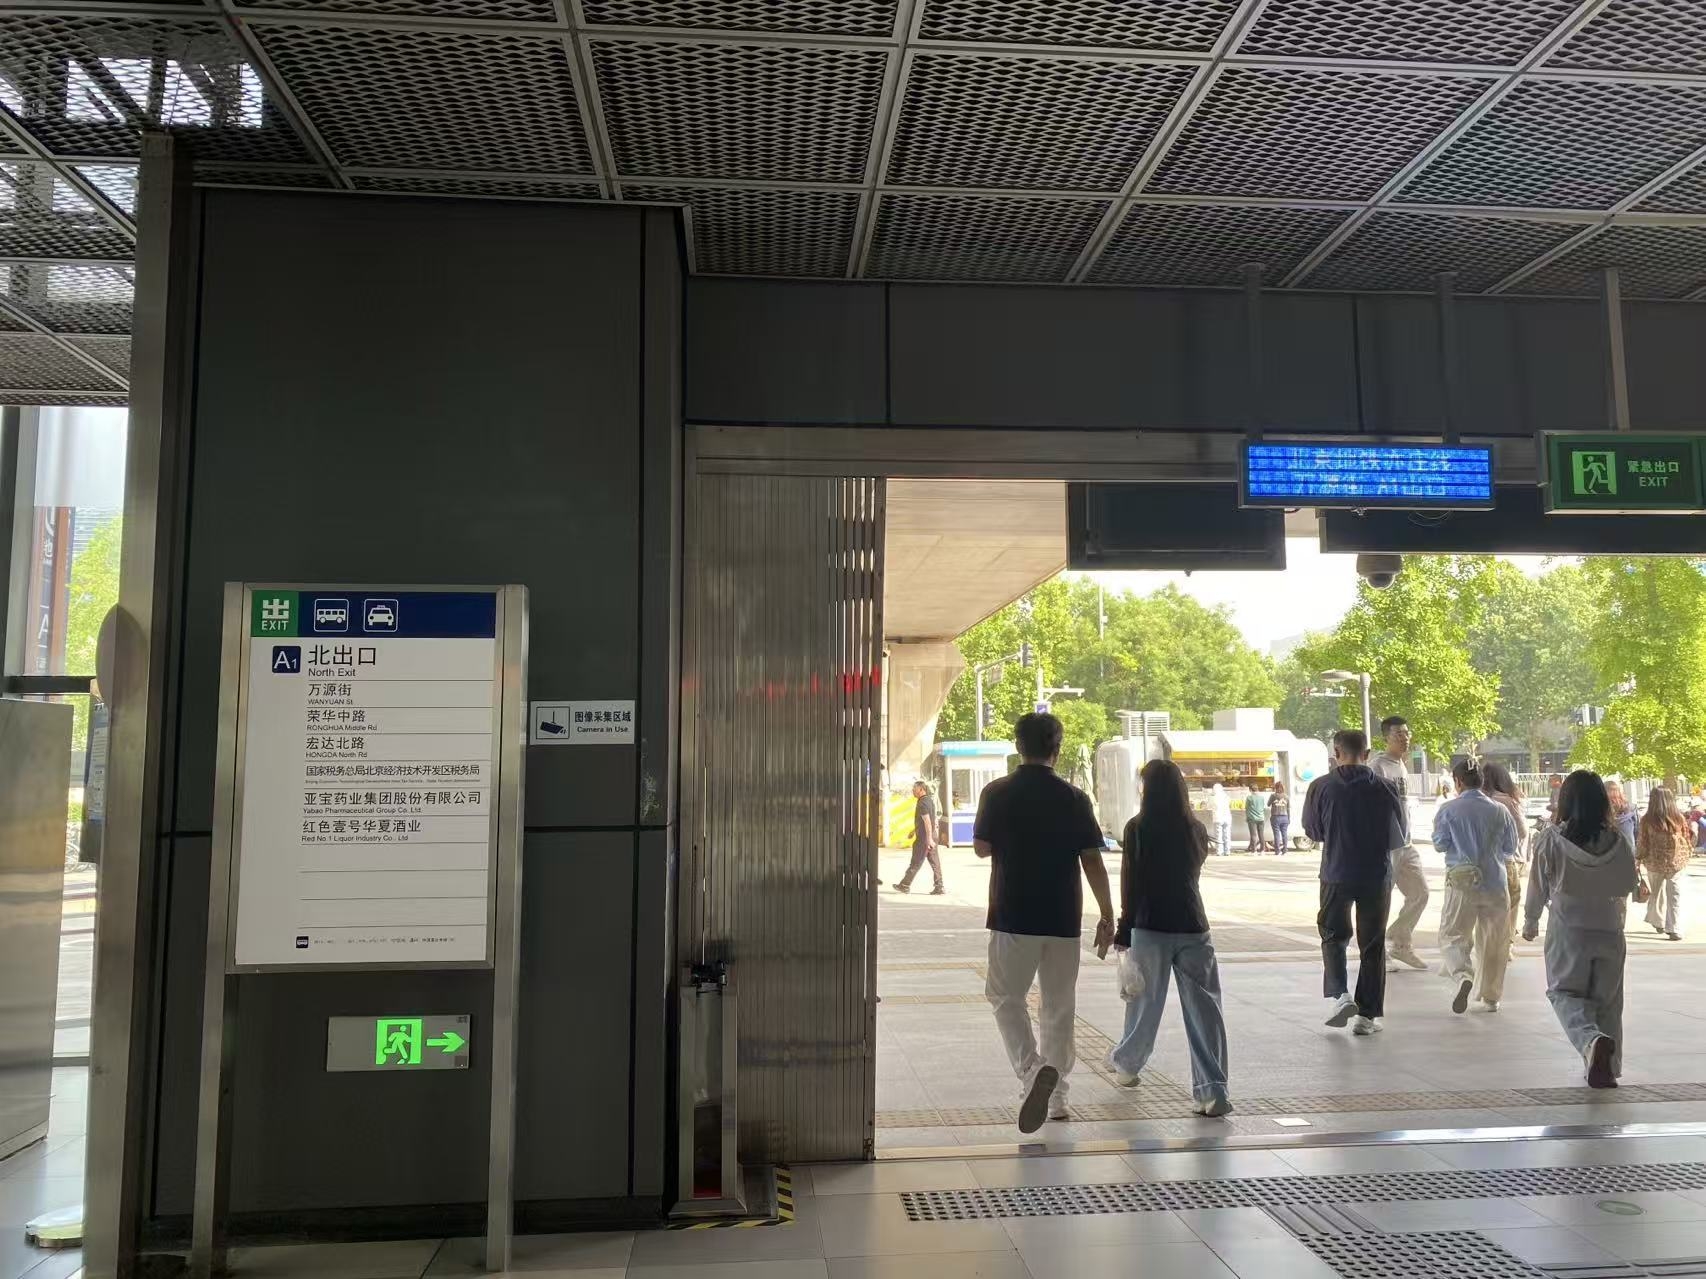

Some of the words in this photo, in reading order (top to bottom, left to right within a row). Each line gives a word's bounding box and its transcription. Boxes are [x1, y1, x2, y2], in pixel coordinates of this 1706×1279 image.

[1627, 460, 1679, 473] 紧急出口
[1639, 476, 1669, 487] EXIT
[262, 598, 290, 620] 出
[261, 620, 289, 631] EXIT
[273, 650, 297, 669] A1
[308, 644, 376, 666] 北出口
[308, 668, 335, 677] North
[338, 668, 356, 677] Exit
[308, 683, 352, 697] 万源街
[307, 698, 345, 706] WANYUAN
[307, 709, 366, 723] 荣华中路
[575, 711, 631, 722] 图像采集区域
[306, 736, 365, 750] 宏达北路
[306, 765, 480, 777] 国家税务总局北京经济技术开发区税务局
[304, 791, 481, 806] 亚宝药业集团股份有限公司
[376, 807, 396, 815] Group
[303, 819, 421, 834] 红色壹号华夏酒业
[333, 835, 354, 843] Liquor
[355, 834, 381, 842] Industry
